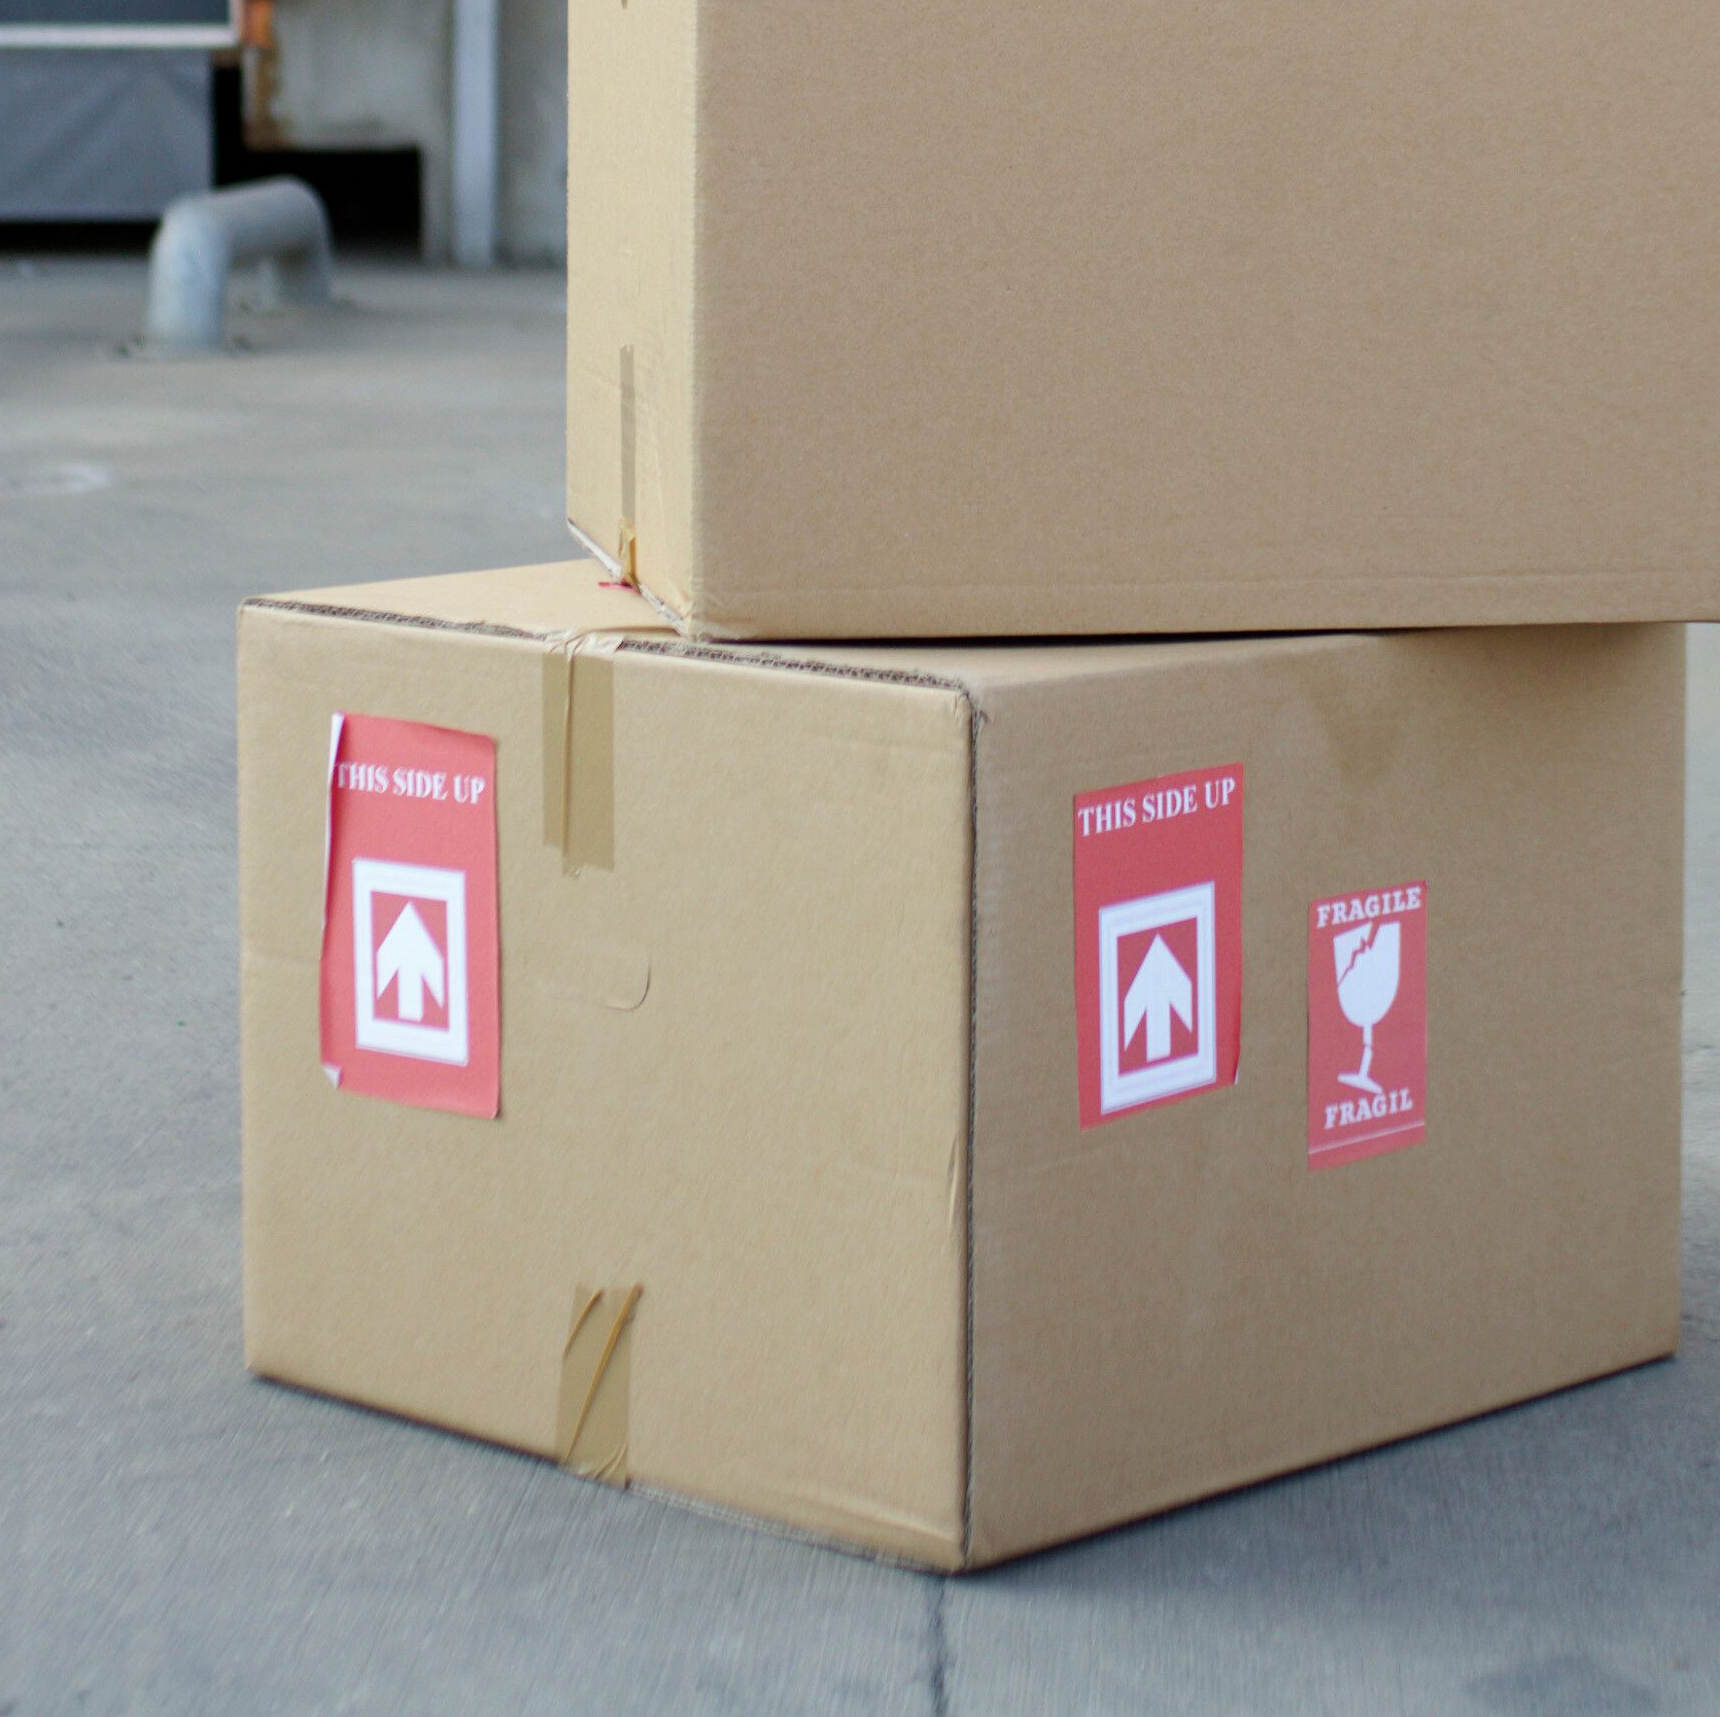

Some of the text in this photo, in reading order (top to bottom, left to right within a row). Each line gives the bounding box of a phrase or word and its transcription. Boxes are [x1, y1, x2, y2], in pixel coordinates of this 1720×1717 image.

[337, 763, 487, 805] THIS SIDE UP
[1078, 777, 1235, 837] THIS SIDE UP
[1316, 886, 1421, 928] FRAGILE
[1324, 1087, 1413, 1129] FRAGIL
